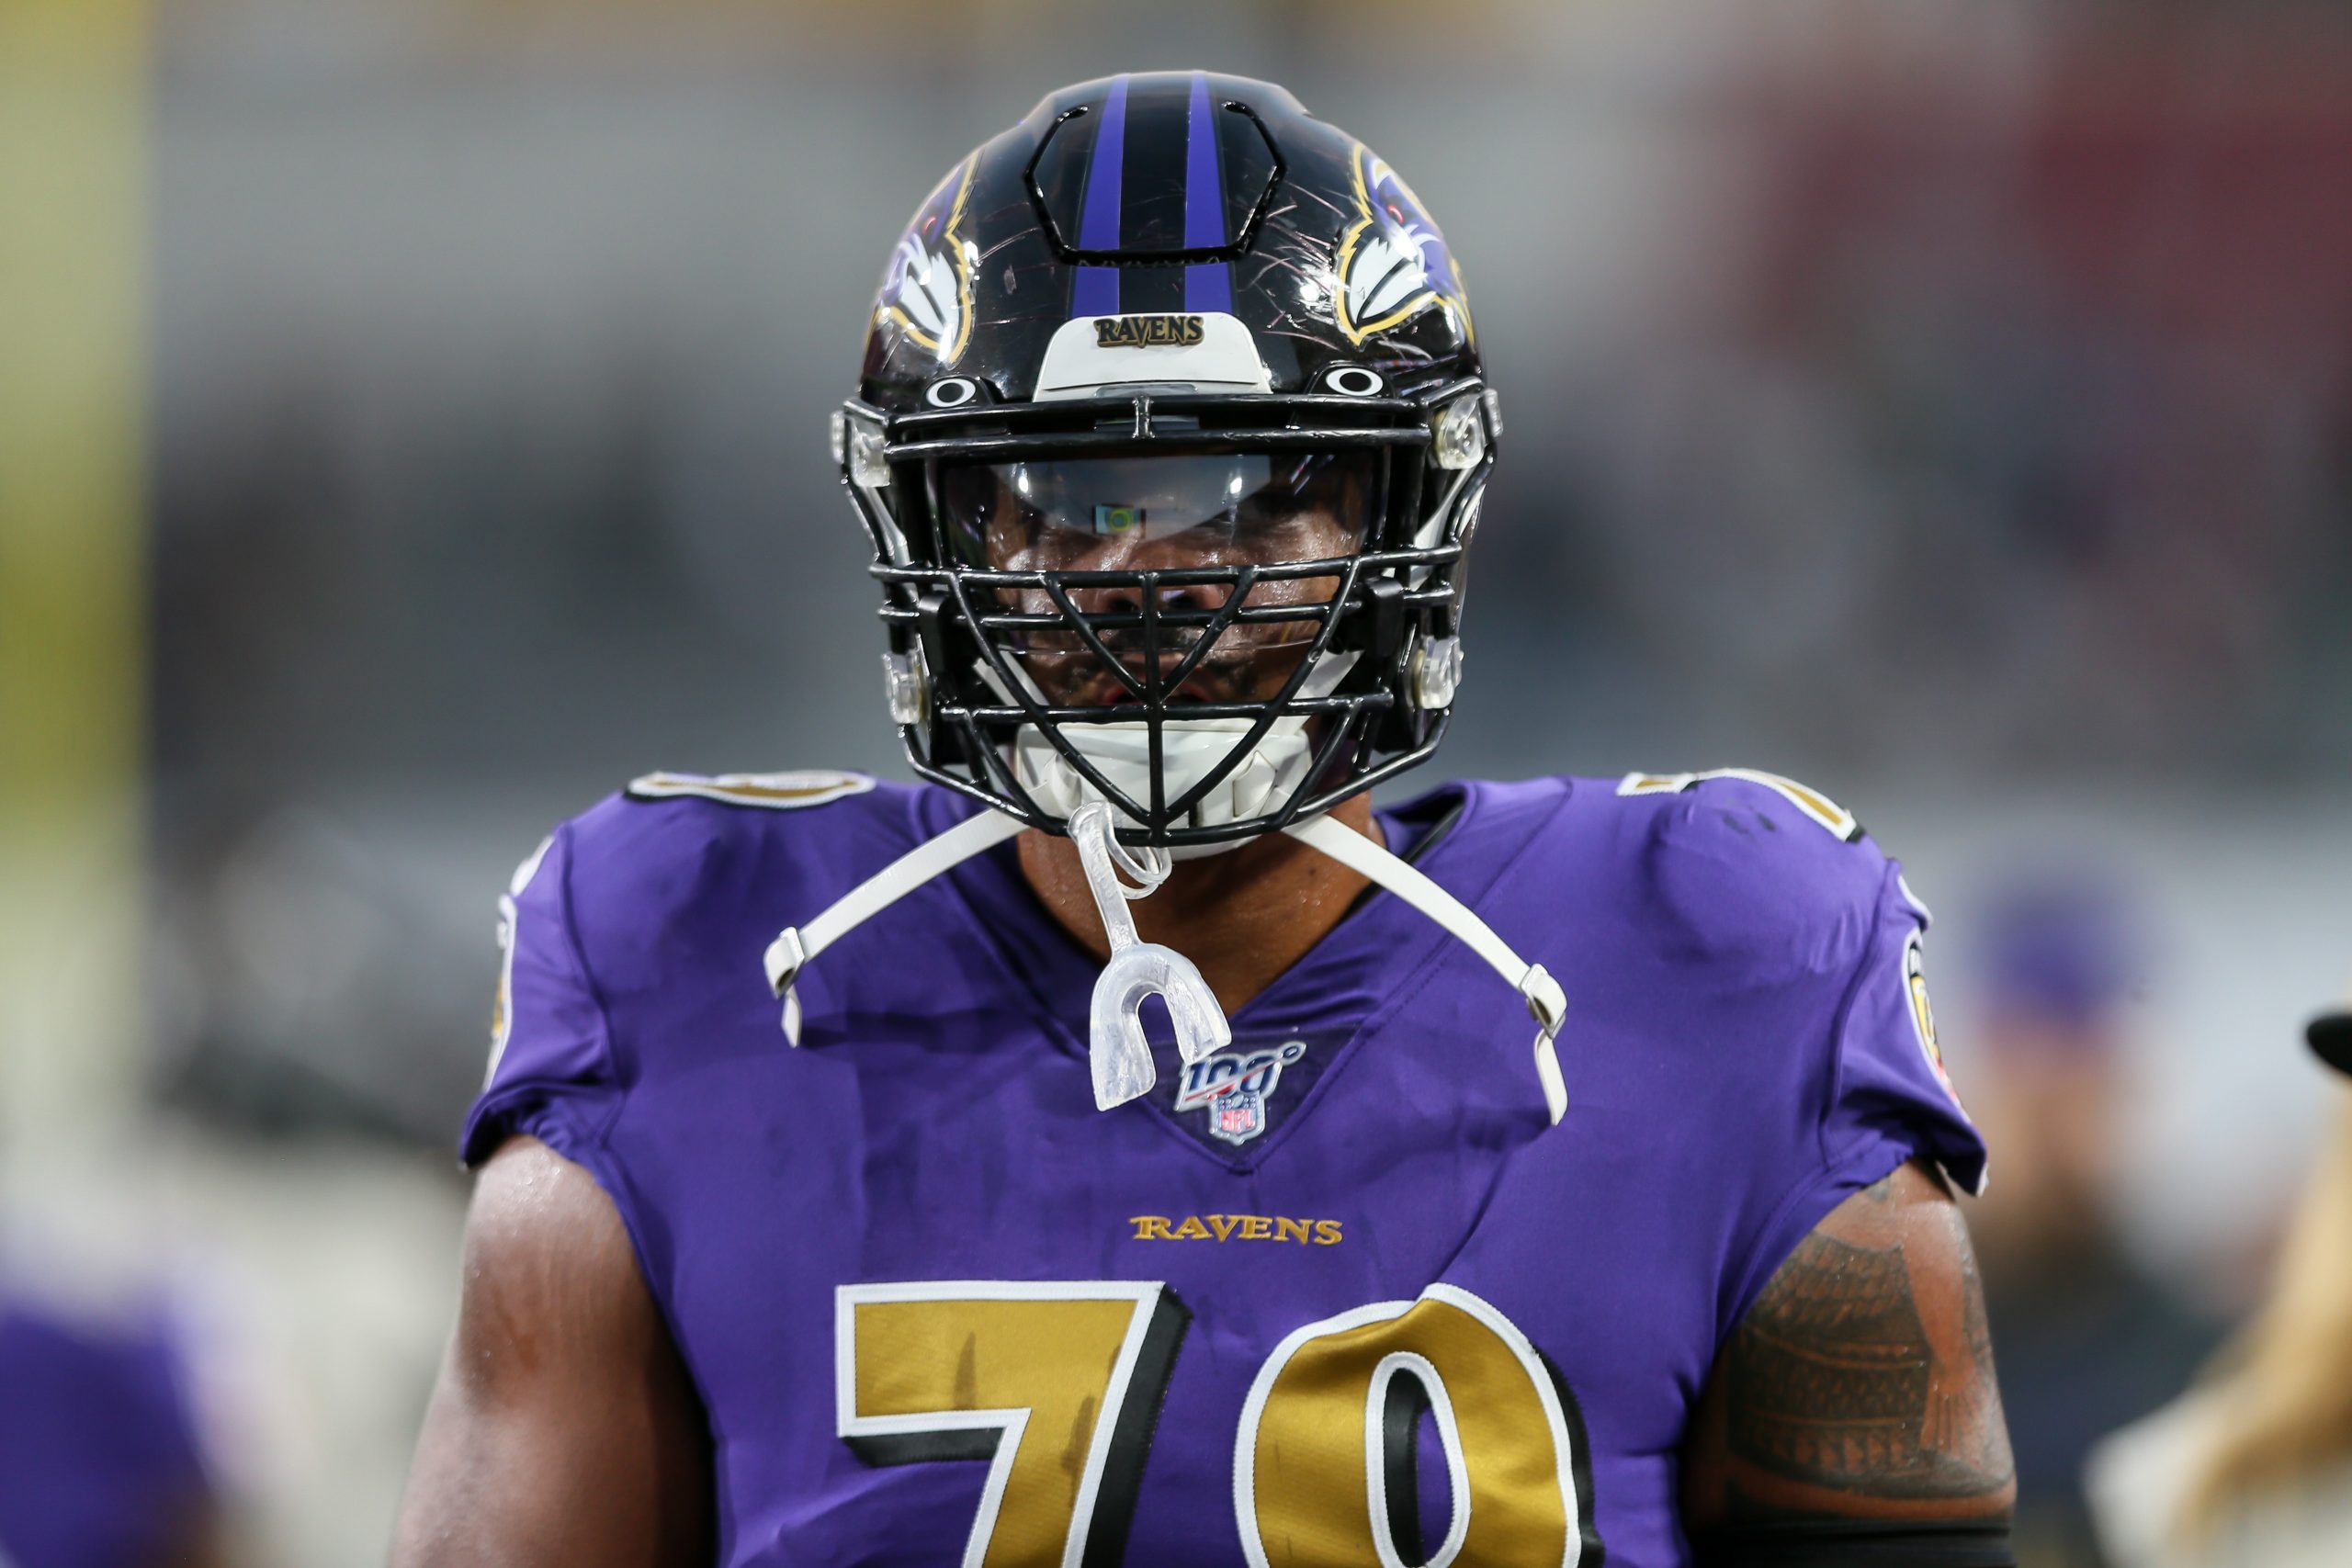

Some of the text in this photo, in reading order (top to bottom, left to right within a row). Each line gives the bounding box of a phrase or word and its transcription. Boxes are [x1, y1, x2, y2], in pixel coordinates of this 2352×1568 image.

[1093, 316, 1204, 348] RAVENS
[1220, 1110, 1256, 1133] NFL
[1129, 1214, 1342, 1245] RAVENS
